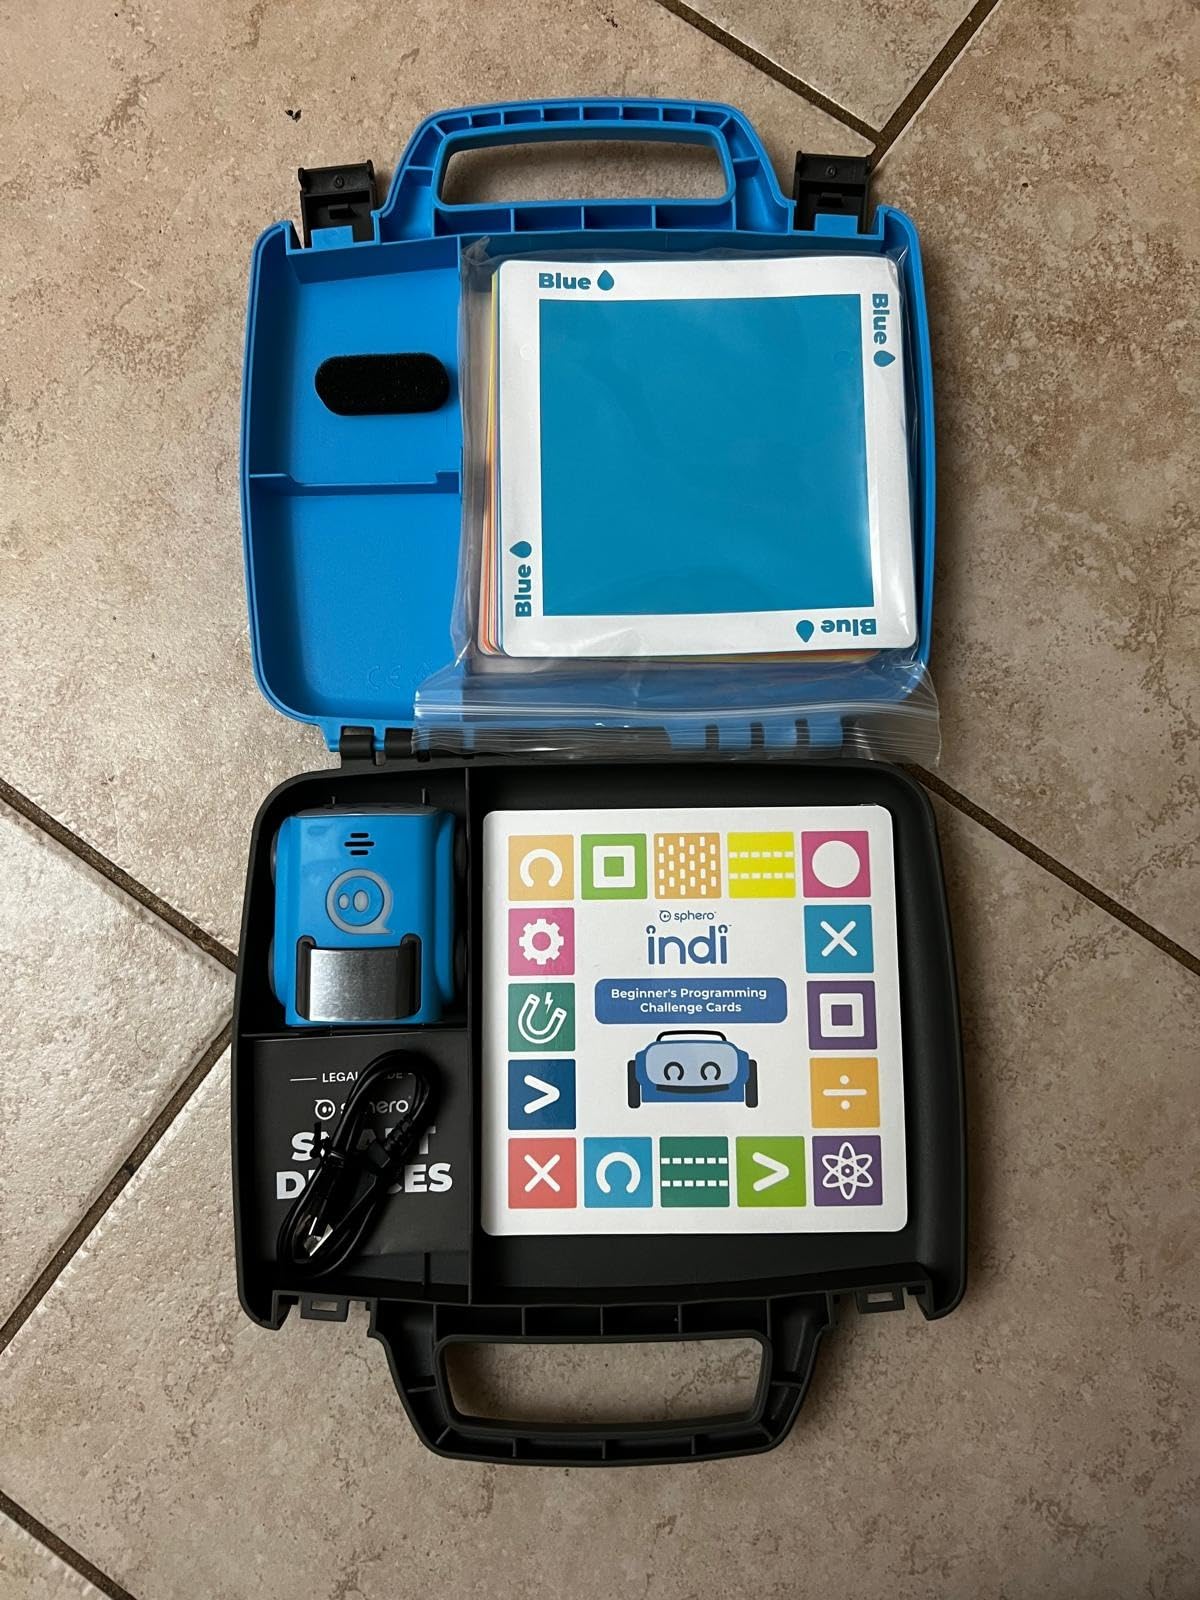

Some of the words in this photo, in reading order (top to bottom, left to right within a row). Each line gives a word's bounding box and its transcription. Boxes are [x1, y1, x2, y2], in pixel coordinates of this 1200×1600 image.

[539, 273, 592, 290] Blue
[872, 294, 890, 345] Blue
[514, 564, 531, 617] Blue
[820, 619, 876, 636] Blue
[674, 910, 715, 923] sphero
[646, 924, 729, 965] indi
[611, 988, 677, 1000] Beginner's
[680, 988, 767, 1001] Programming
[640, 1002, 703, 1014] Challenge
[706, 1002, 742, 1013] Cards
